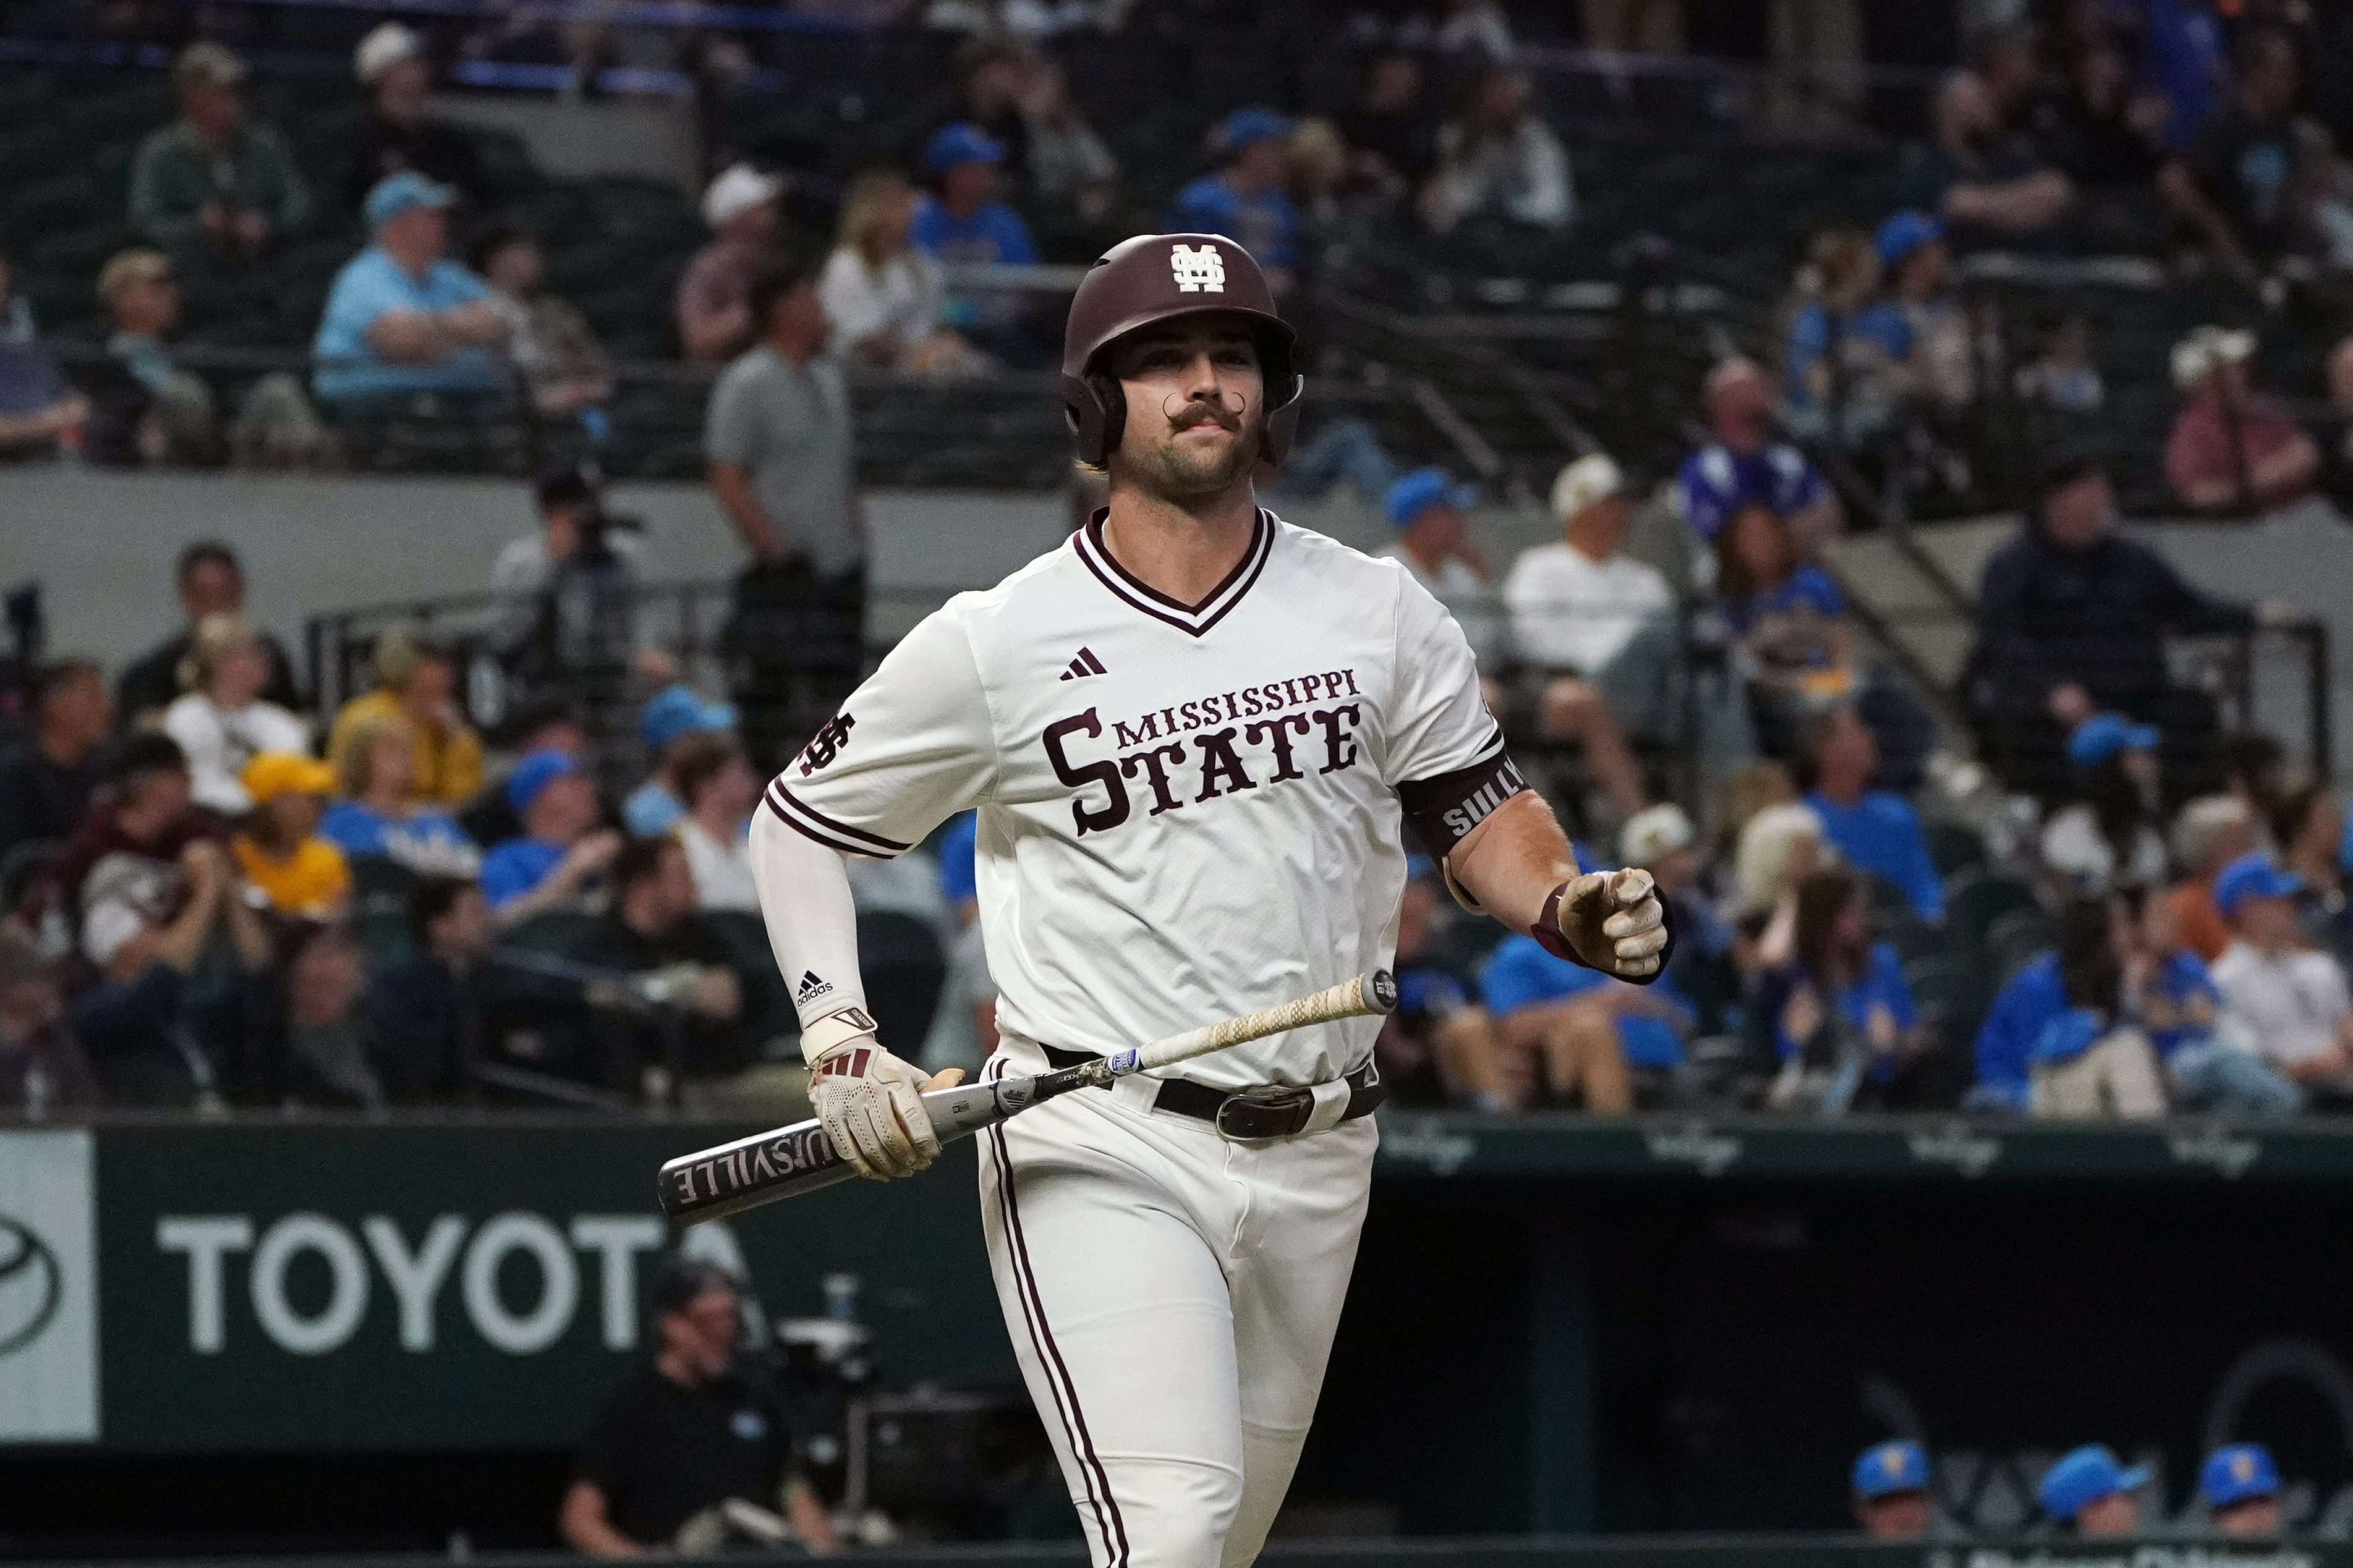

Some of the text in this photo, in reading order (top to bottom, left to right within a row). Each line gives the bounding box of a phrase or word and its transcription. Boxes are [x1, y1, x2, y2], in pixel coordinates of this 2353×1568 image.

[1112, 669, 1361, 749] MISSISSIPPI
[1042, 703, 1361, 837] STATE
[1442, 753, 1524, 836] SULLY
[797, 982, 833, 1007] adidas
[851, 1009, 872, 1027] ADIZERO
[674, 1127, 835, 1204] UISVILLE
